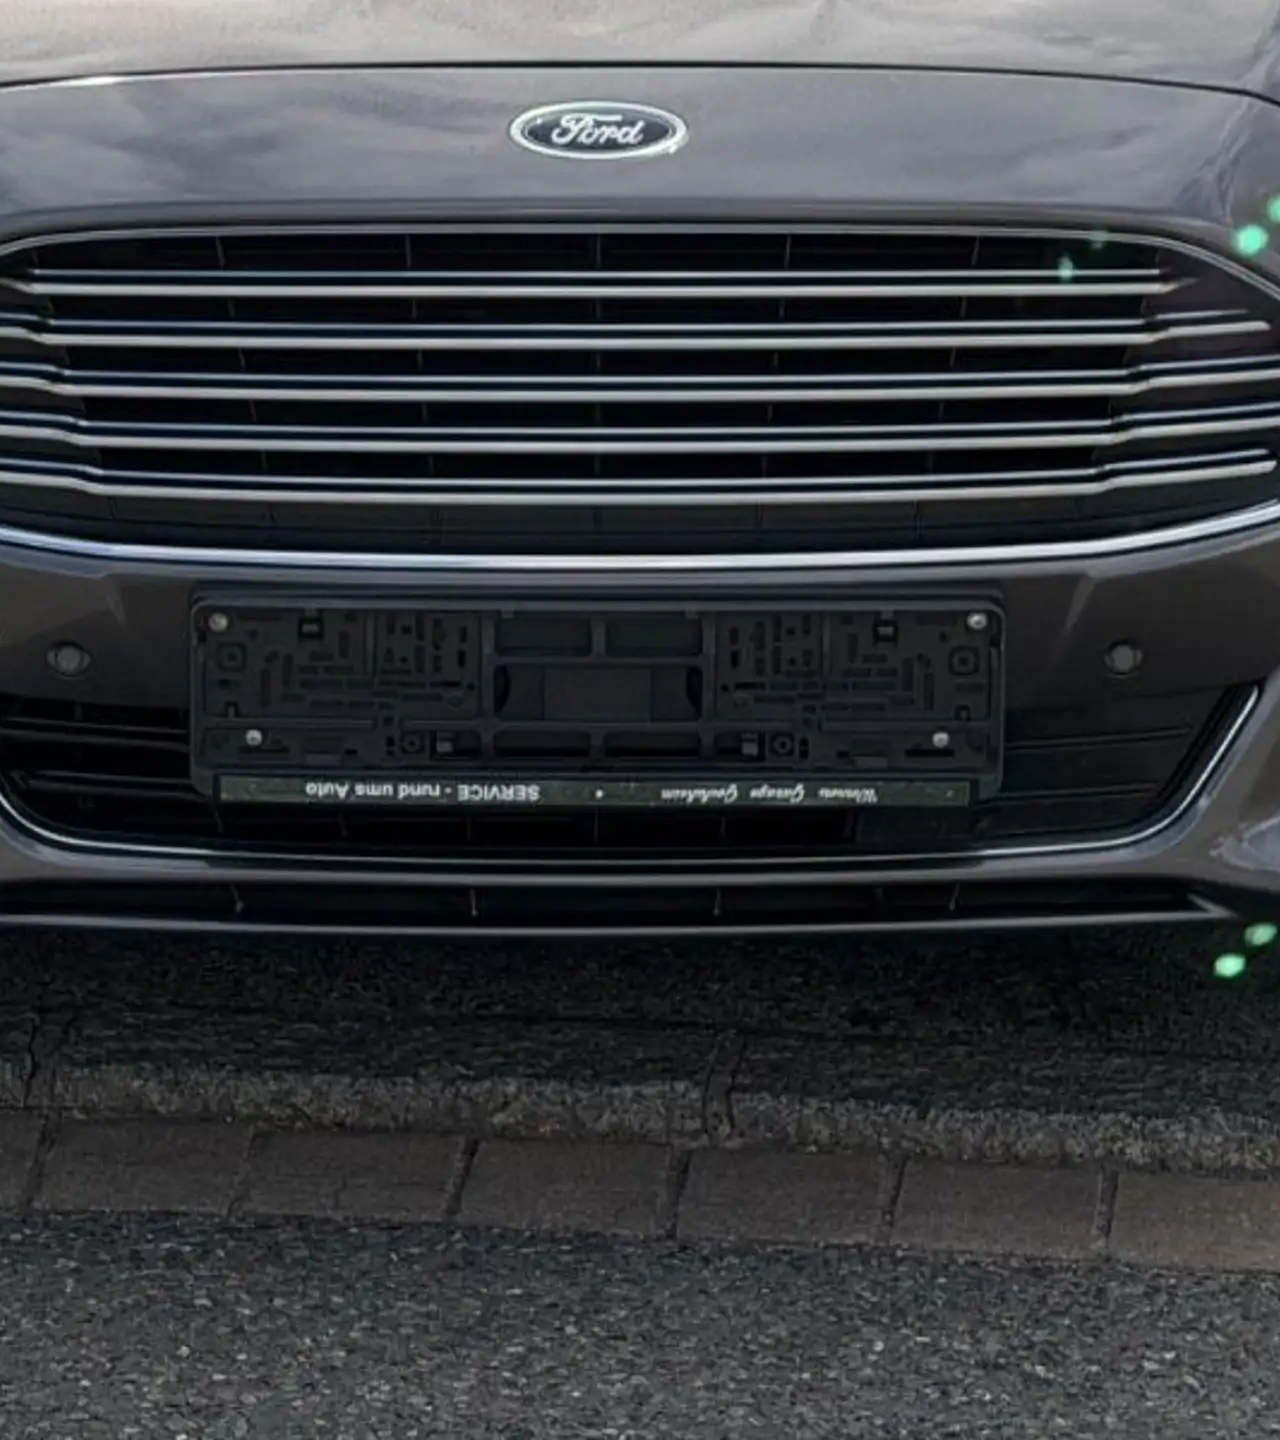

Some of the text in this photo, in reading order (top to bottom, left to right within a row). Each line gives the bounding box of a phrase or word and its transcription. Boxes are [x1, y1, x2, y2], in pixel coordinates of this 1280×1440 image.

[550, 113, 646, 144] Ford
[305, 782, 349, 799] Auto
[354, 783, 394, 796] ums
[398, 784, 440, 798] rund
[457, 784, 540, 801] SERVICE
